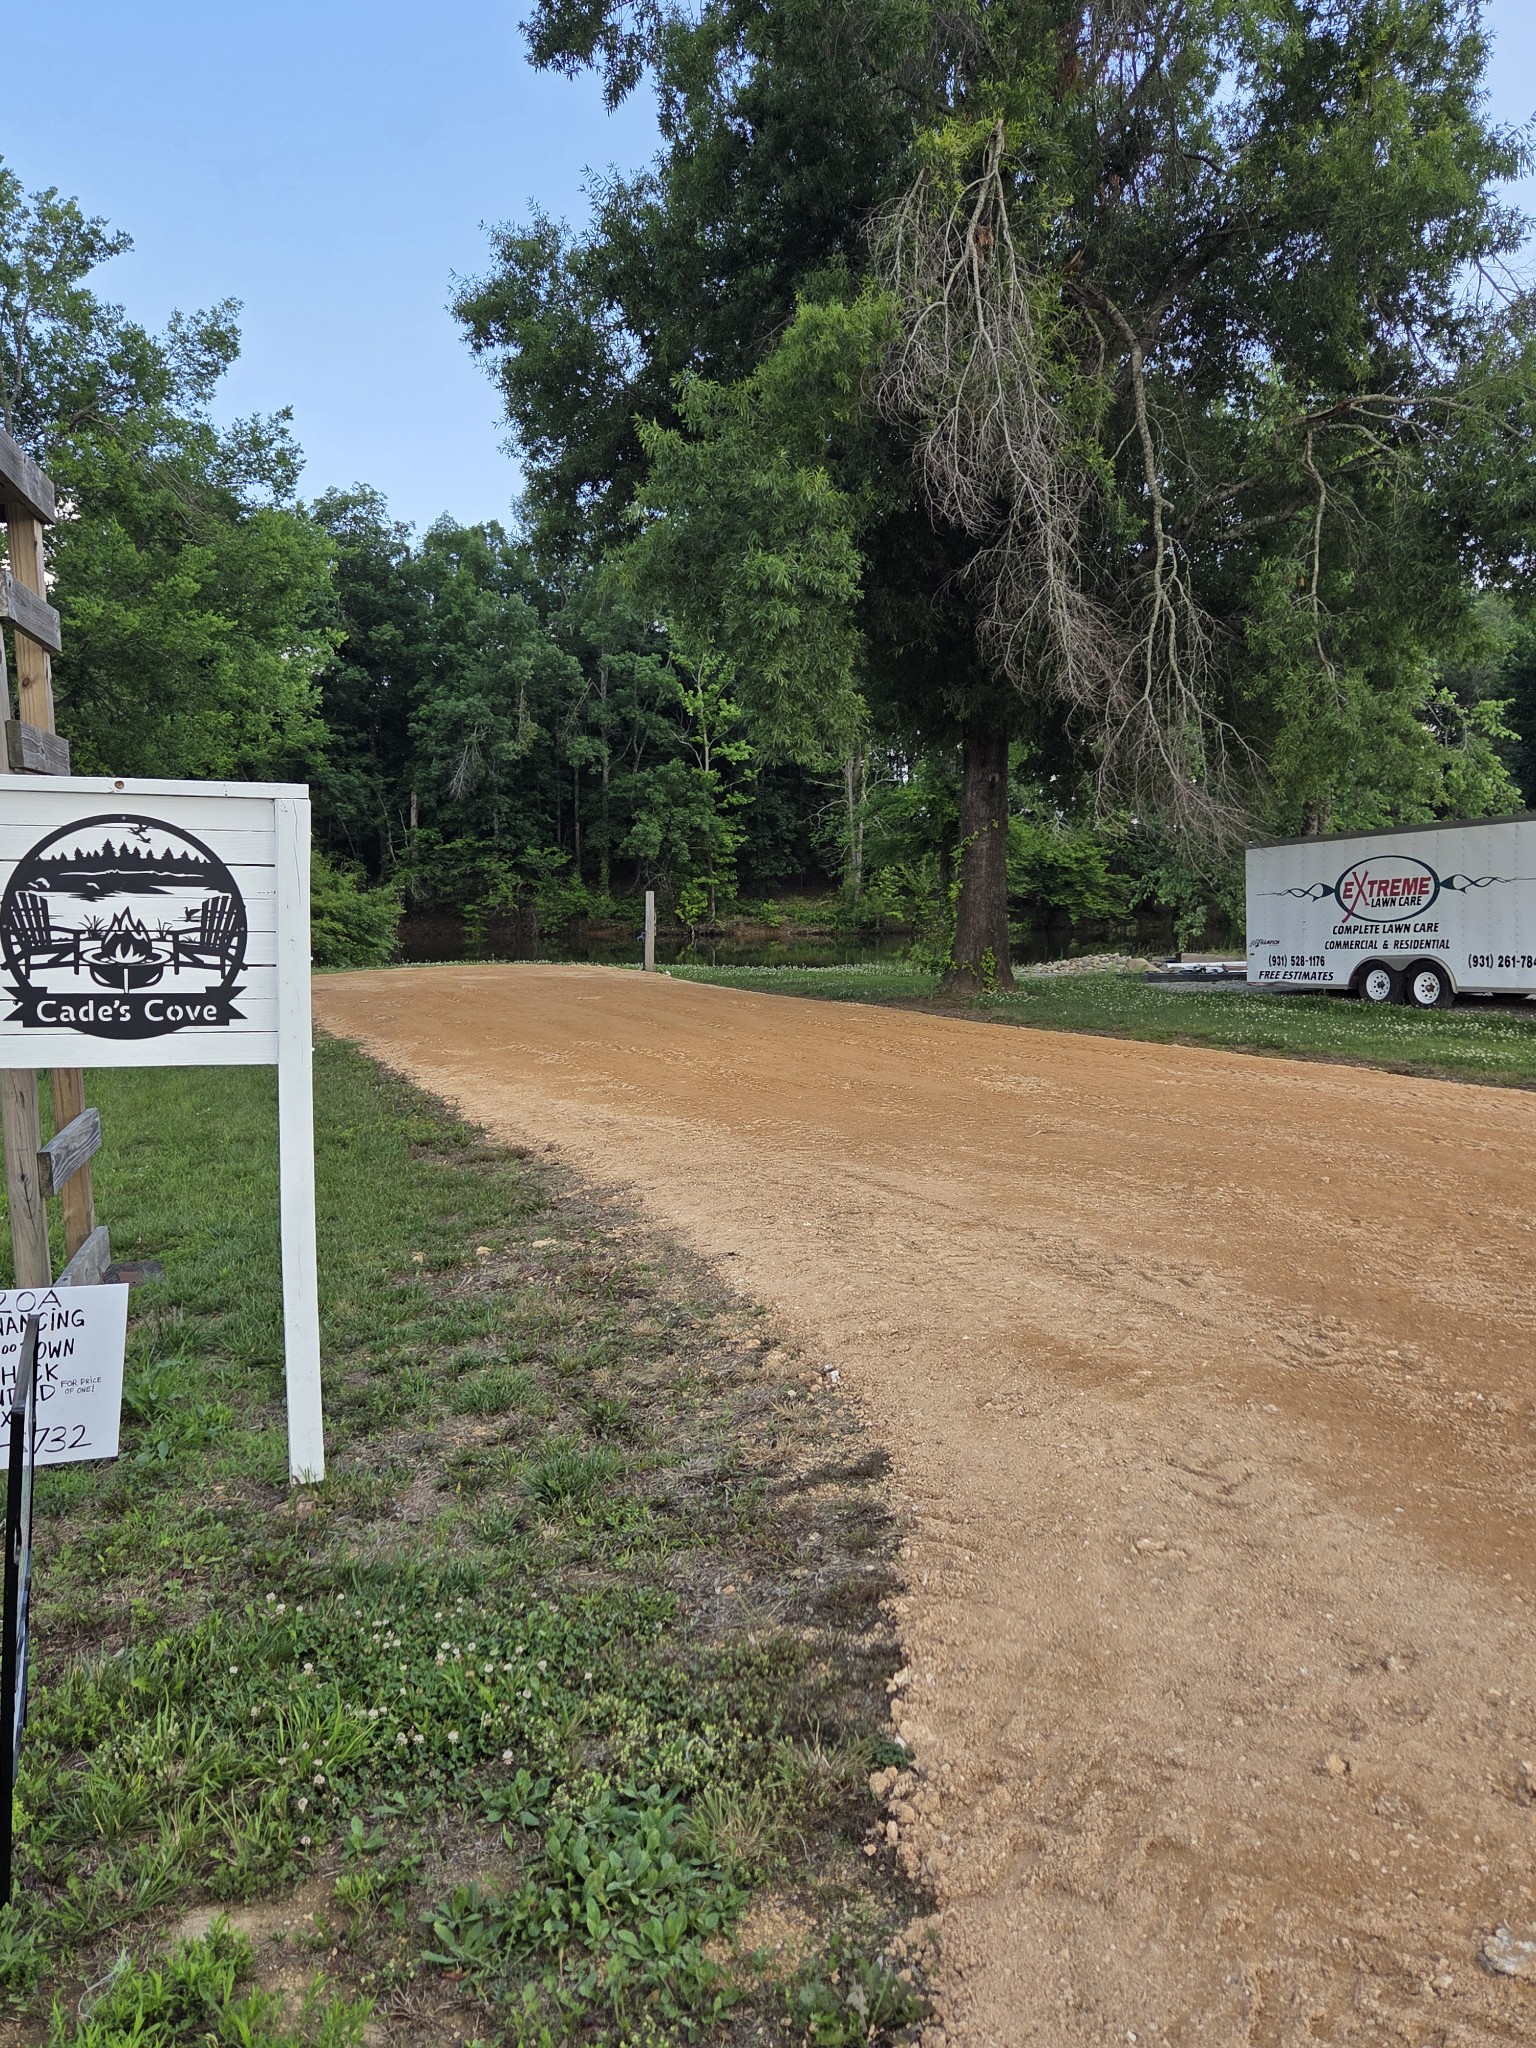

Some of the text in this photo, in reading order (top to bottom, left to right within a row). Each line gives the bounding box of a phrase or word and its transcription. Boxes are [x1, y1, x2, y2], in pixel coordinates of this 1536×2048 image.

[1342, 870, 1432, 923] EXTREME
[1371, 896, 1422, 908] LAWN CARE
[1332, 922, 1440, 935] COMPLETE LAWN CARE
[1324, 939, 1451, 950] COMMERCIAL & RESIDENTIAL
[1268, 954, 1325, 967] (931) 528-1176
[1468, 953, 1494, 969] (931)
[1259, 970, 1334, 981] FREE ESTIMATES
[36, 999, 217, 1022] Cade's Cove
[20, 1338, 75, 1360] OWN
[60, 1376, 102, 1388] FOR PRICE
[76, 1385, 95, 1394] ONE!
